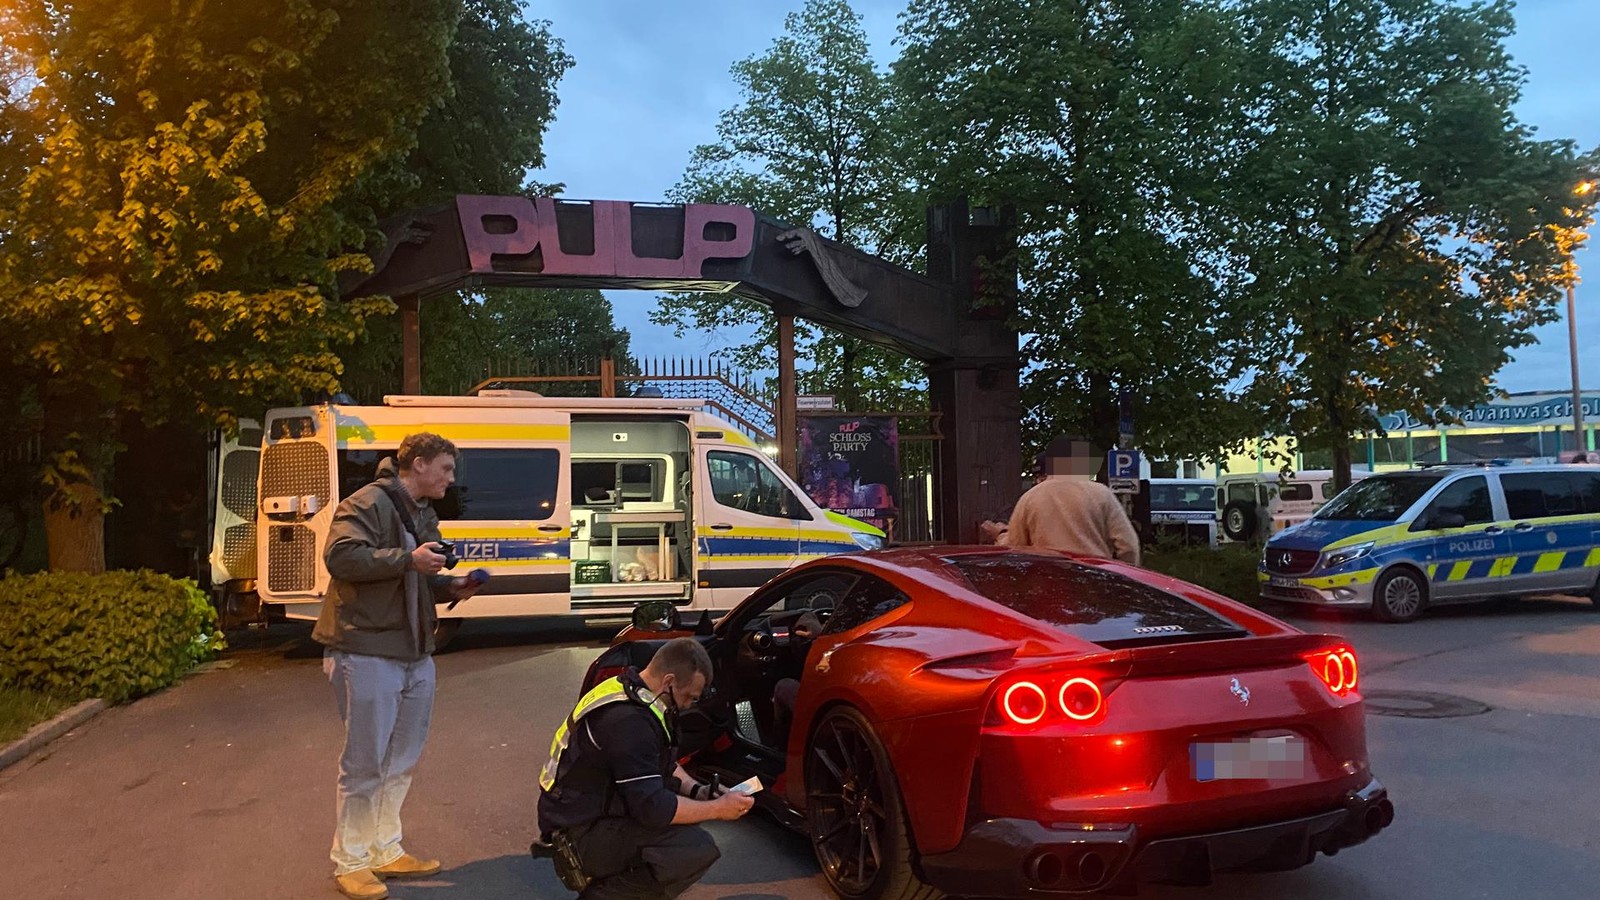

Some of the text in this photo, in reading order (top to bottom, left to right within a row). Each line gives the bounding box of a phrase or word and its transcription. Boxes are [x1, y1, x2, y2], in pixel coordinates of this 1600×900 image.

[456, 194, 756, 280] PULP
[829, 433, 872, 443] SCHLOSS
[833, 443, 868, 452] PARTY
[1116, 453, 1133, 477] P
[846, 508, 875, 518] SAMSTAG
[452, 543, 499, 559] LIZEI
[1449, 539, 1495, 553] POLIZEI
